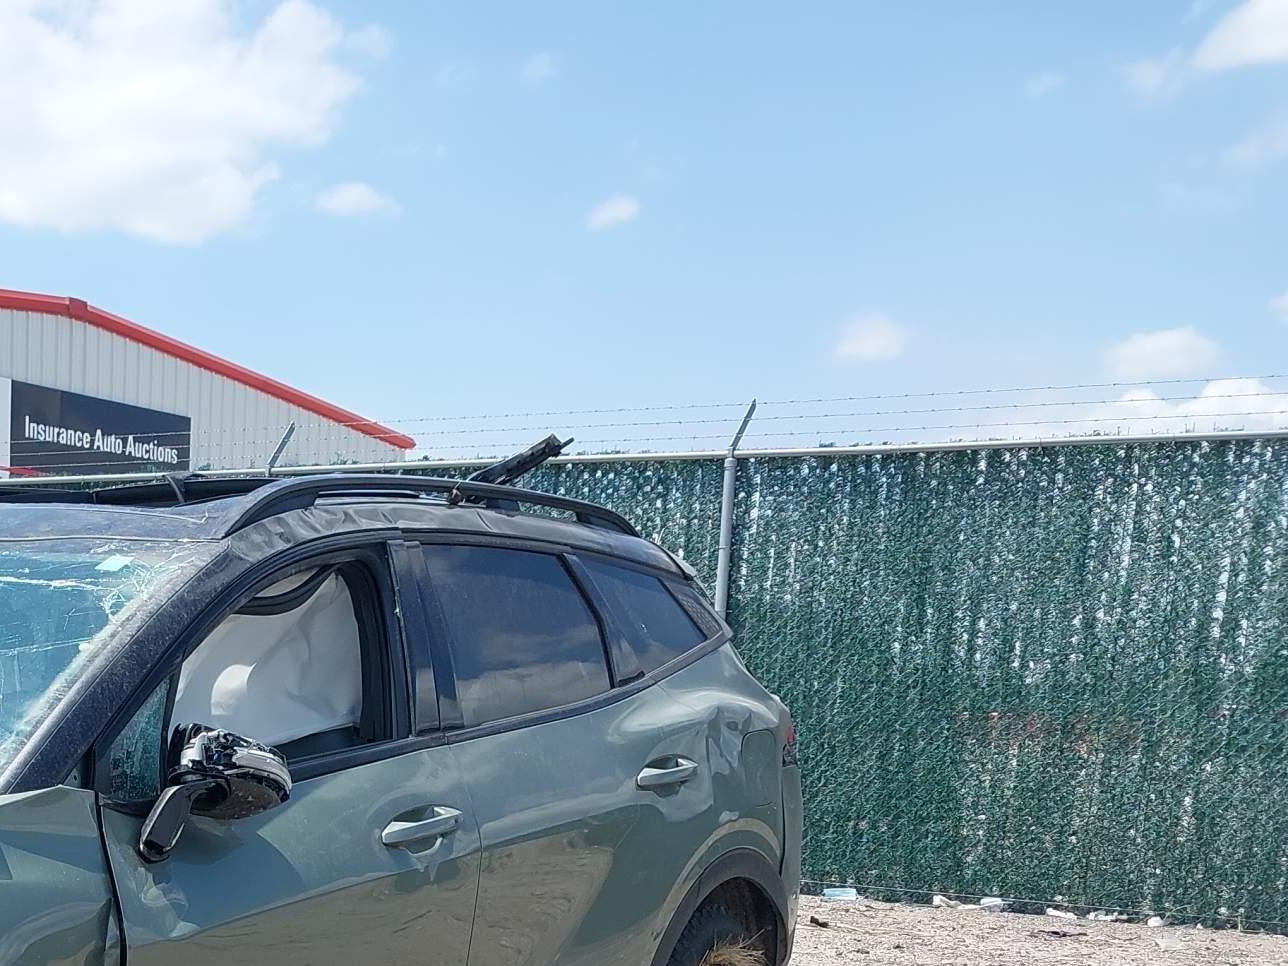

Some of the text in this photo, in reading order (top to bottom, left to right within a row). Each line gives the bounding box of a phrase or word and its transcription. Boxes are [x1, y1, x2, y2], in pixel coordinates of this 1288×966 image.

[24, 415, 179, 464] Insurance Auto Auctions
